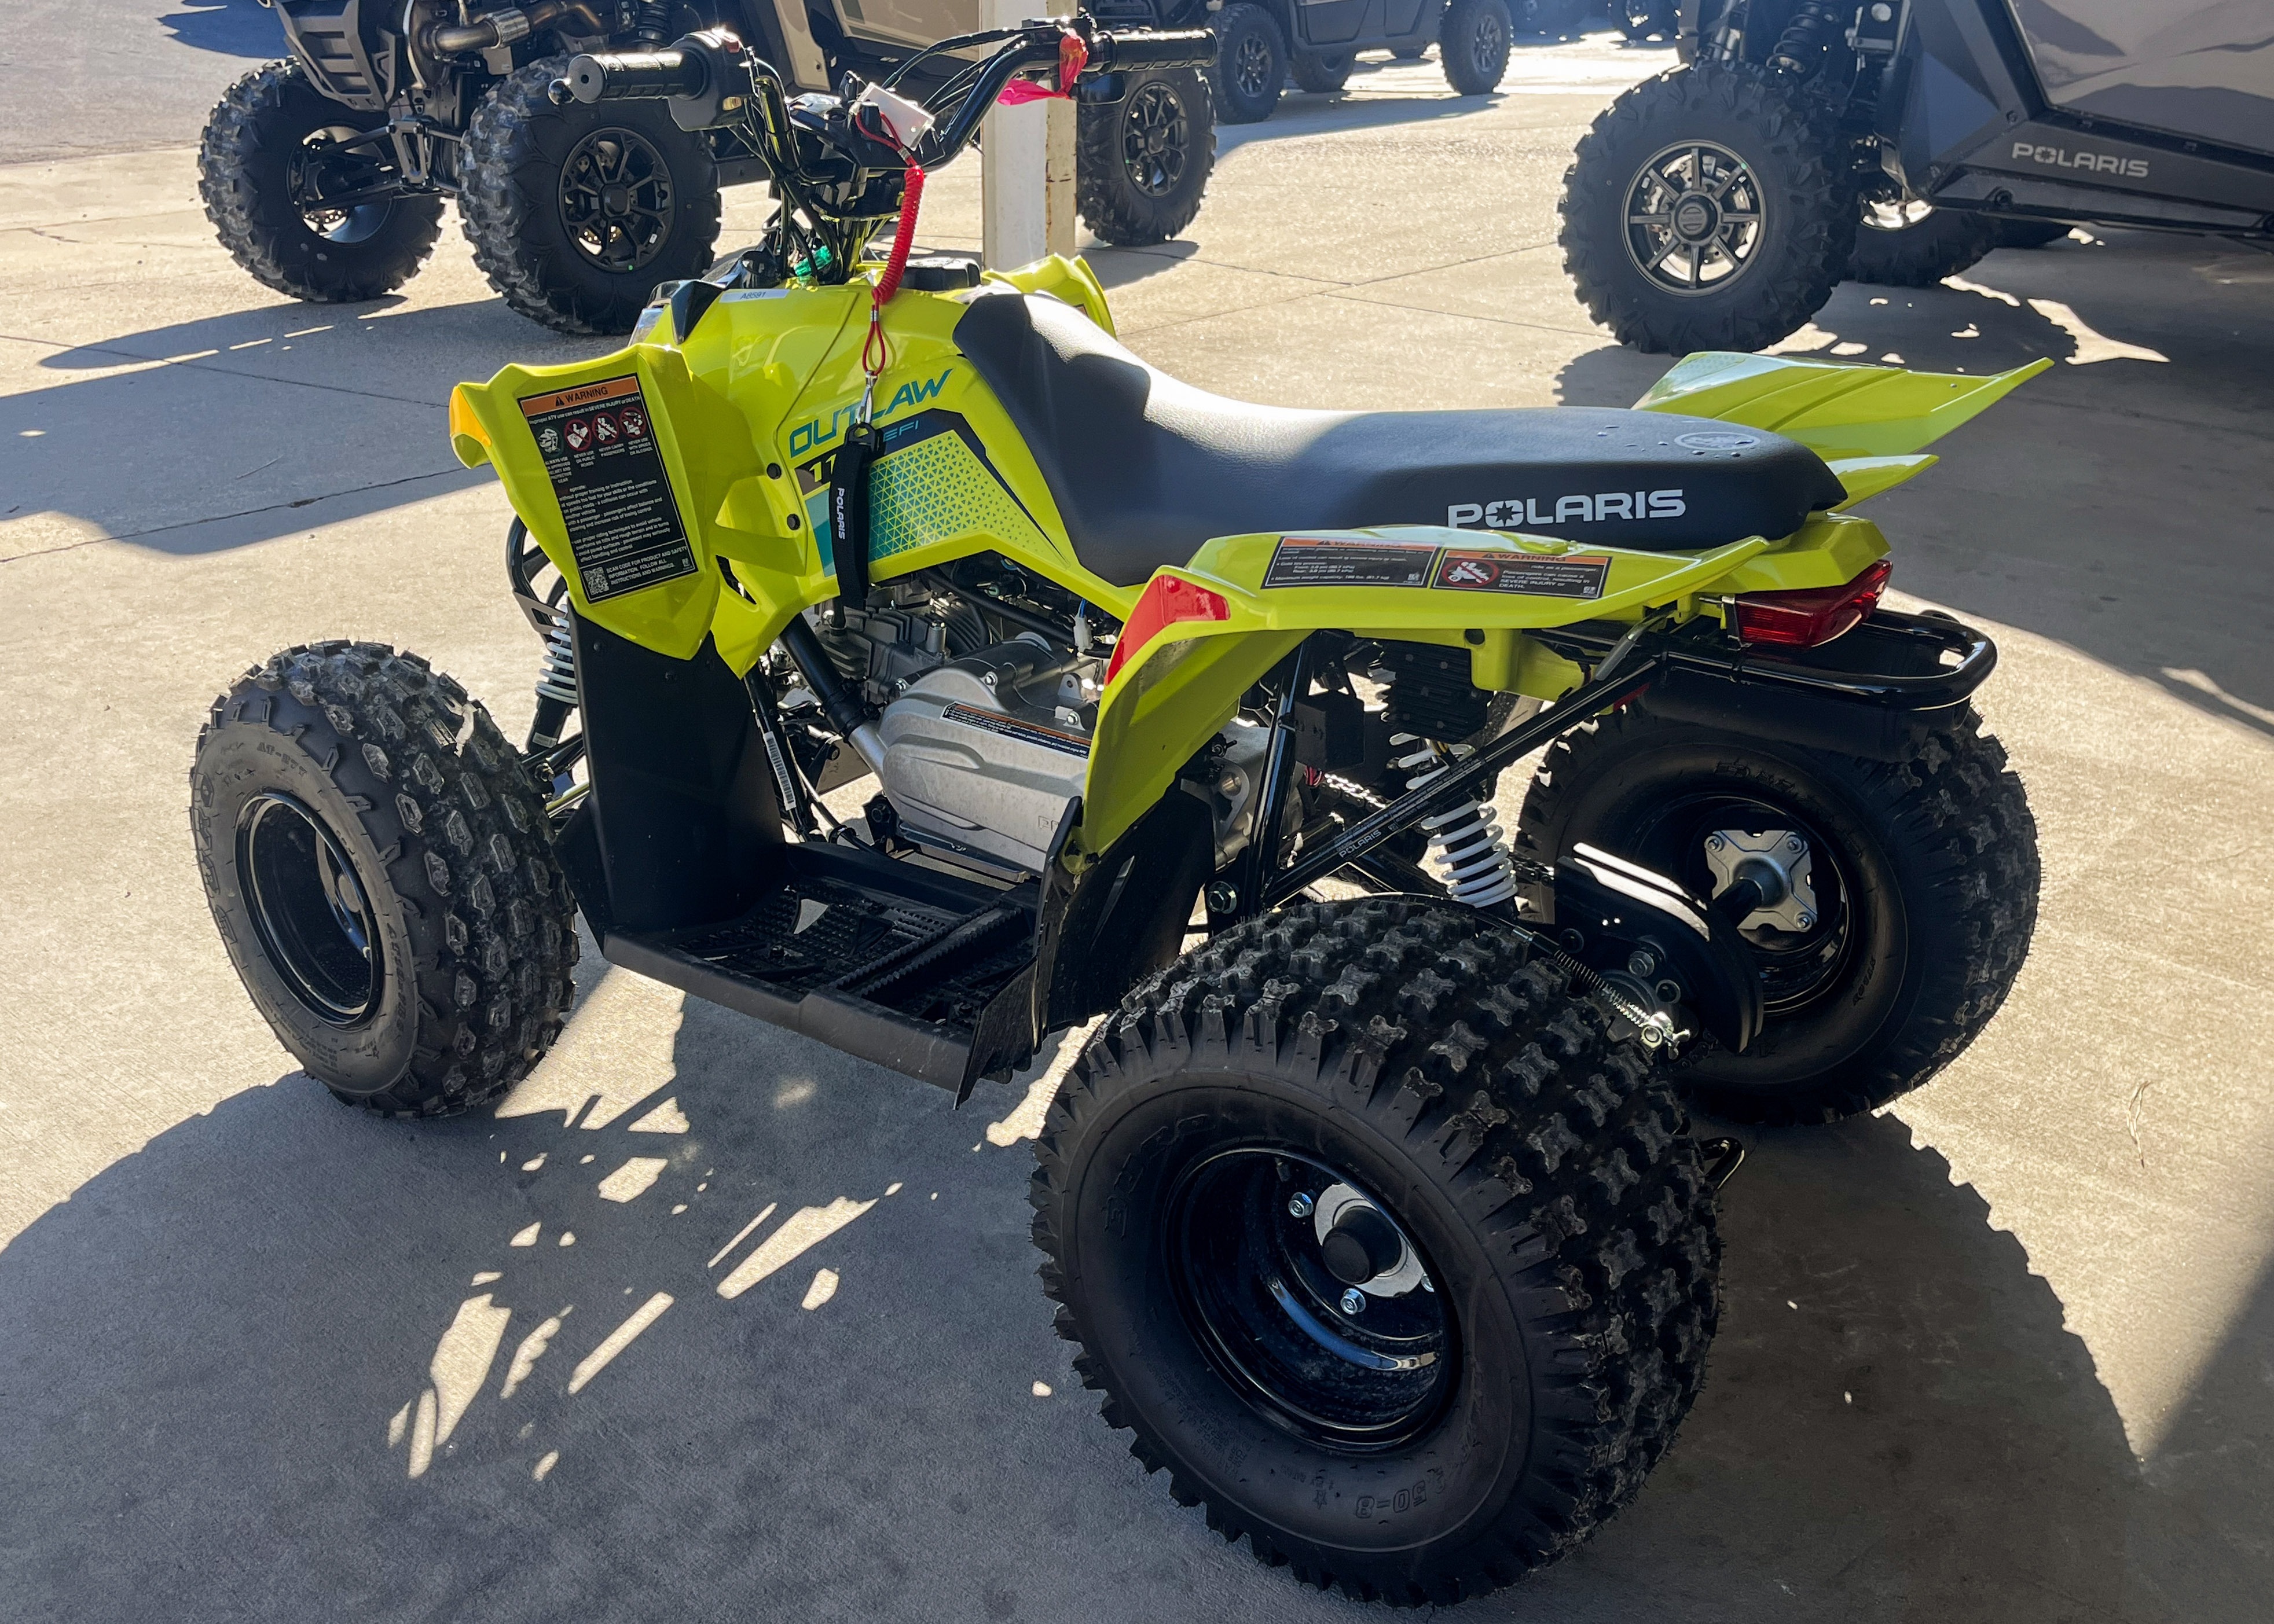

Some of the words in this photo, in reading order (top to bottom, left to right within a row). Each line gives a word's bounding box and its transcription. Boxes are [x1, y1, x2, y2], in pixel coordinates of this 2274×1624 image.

[2012, 142, 2149, 178] POLARIS
[565, 386, 608, 403] WARNING
[790, 369, 953, 458] OUTLAW
[883, 420, 919, 442] EFI
[837, 487, 845, 540] POLARIS
[1448, 488, 1686, 530] POLARIS
[640, 561, 658, 569] FOLLOW
[641, 553, 662, 563] PRODUCT
[1338, 829, 1382, 859] POLARIS
